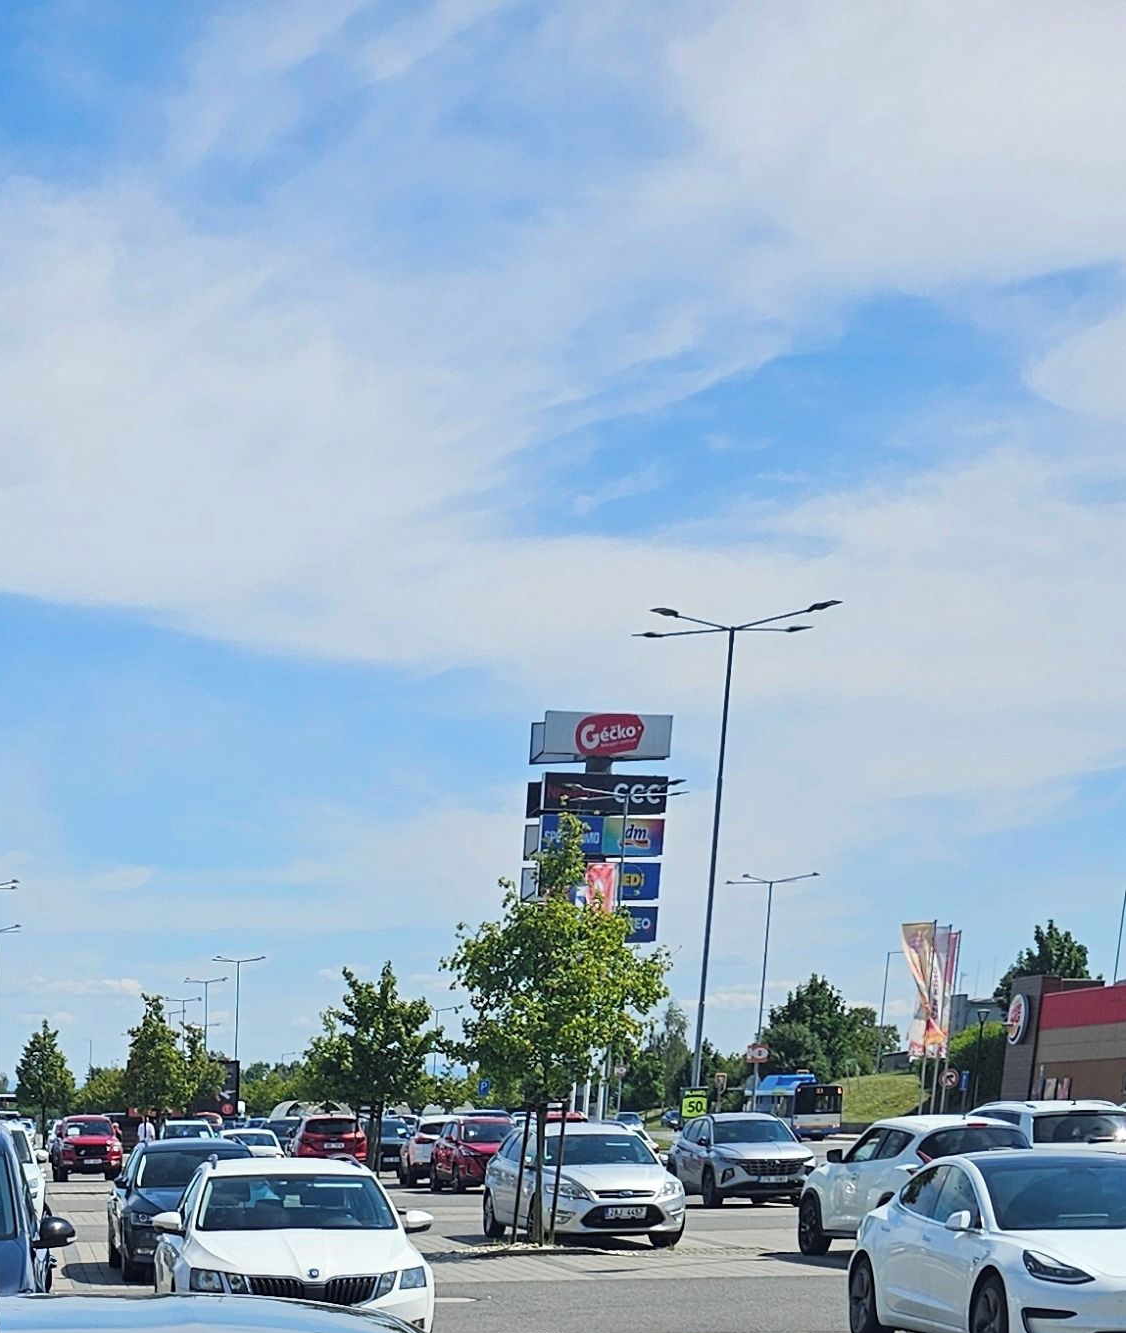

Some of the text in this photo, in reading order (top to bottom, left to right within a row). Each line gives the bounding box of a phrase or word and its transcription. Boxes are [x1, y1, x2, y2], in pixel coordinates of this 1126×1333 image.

[580, 723, 637, 750] Géčko
[614, 783, 662, 804] CCC
[625, 824, 647, 840] dm
[687, 1100, 703, 1112] 50
